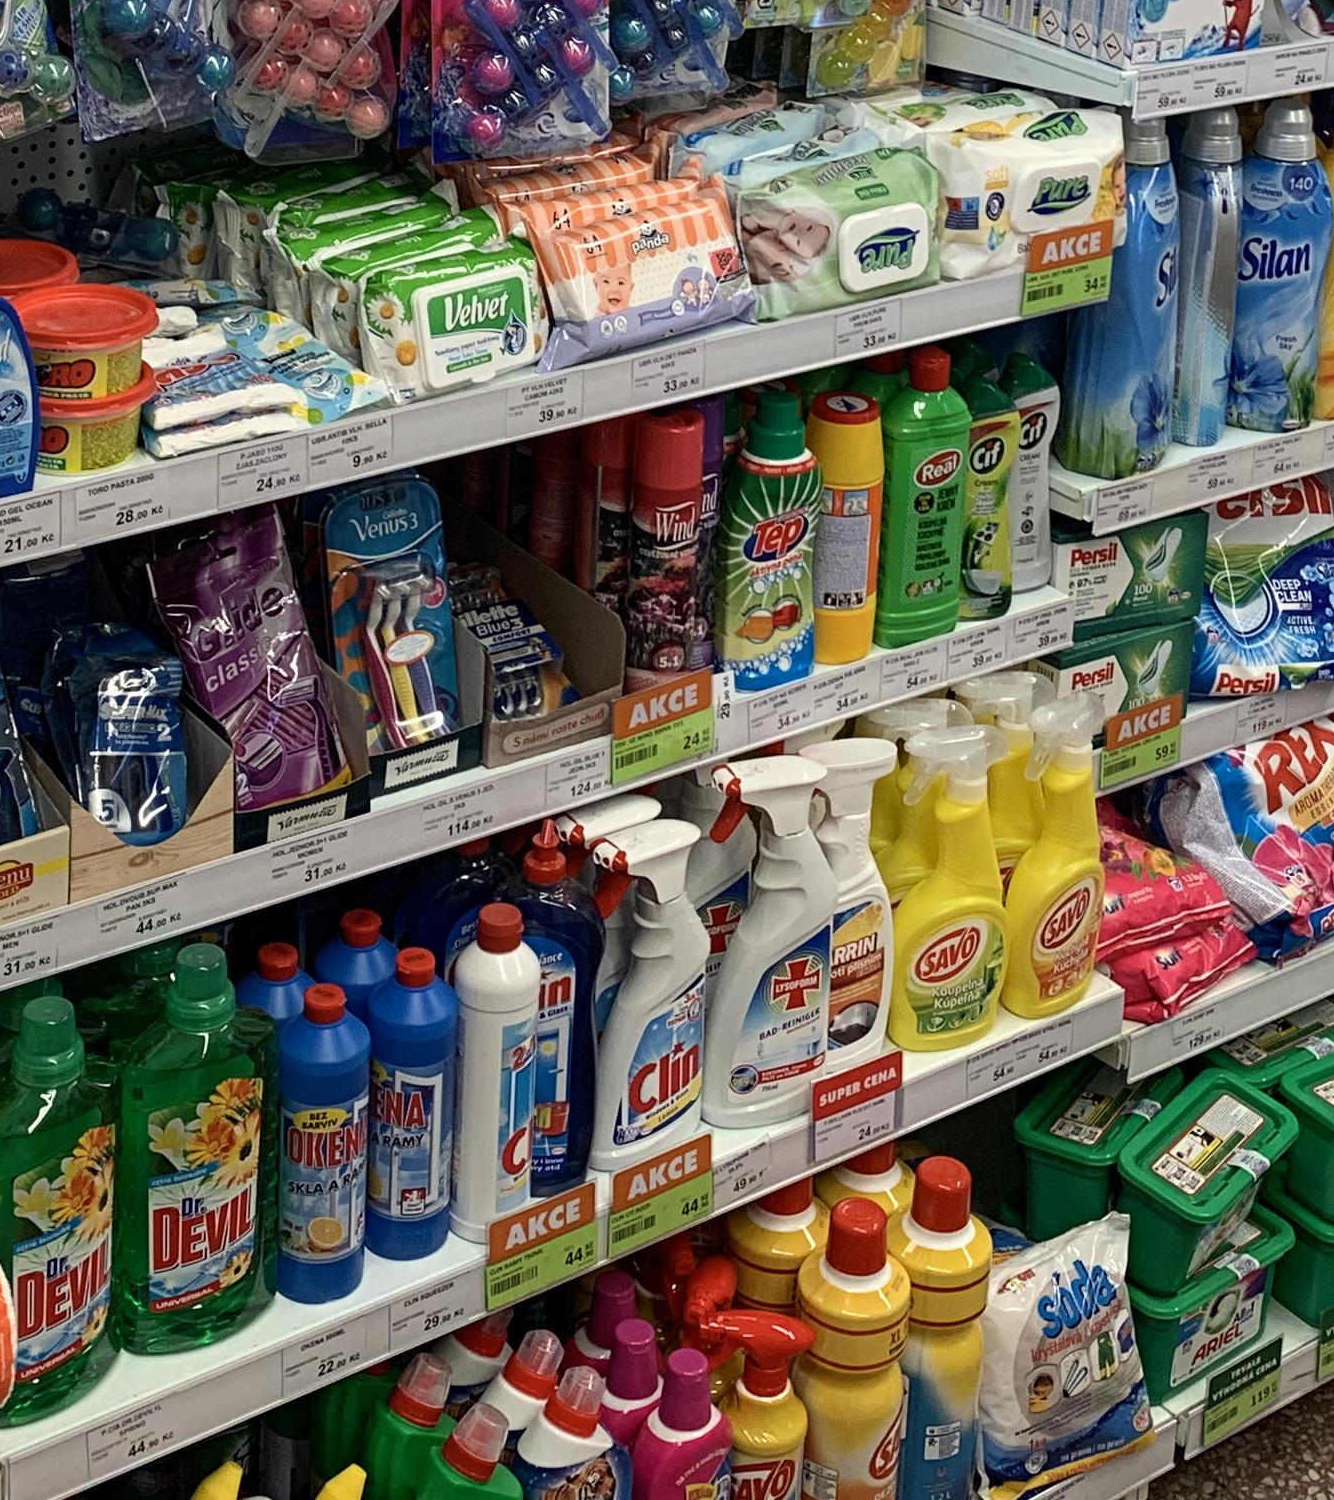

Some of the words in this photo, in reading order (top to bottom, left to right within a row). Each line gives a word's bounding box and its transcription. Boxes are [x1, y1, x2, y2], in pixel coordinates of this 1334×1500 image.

[632, 232, 669, 255] panda
[1041, 233, 1101, 261] AKCE
[1238, 239, 1310, 280] Silan
[444, 289, 509, 330] Velvet
[922, 456, 957, 479] Real
[972, 442, 1000, 470] Cif
[350, 517, 405, 541] Venus
[407, 513, 418, 530] 3
[655, 508, 695, 543] Wind
[752, 517, 805, 556] Tep
[1070, 546, 1118, 566] Persil
[1217, 672, 1276, 696] Persil
[629, 685, 699, 729] AKCE
[1046, 889, 1090, 945] SAVO
[923, 932, 978, 978] SAVO
[774, 976, 819, 996] LYSOFORM
[627, 1045, 699, 1114] Clin
[819, 1080, 860, 1107] SUPER
[863, 1066, 897, 1092] CENA
[629, 1149, 699, 1199] AKCE
[152, 1198, 252, 1273] DEVIL
[505, 1200, 581, 1244] AKCE
[17, 1247, 108, 1339] DEVIL
